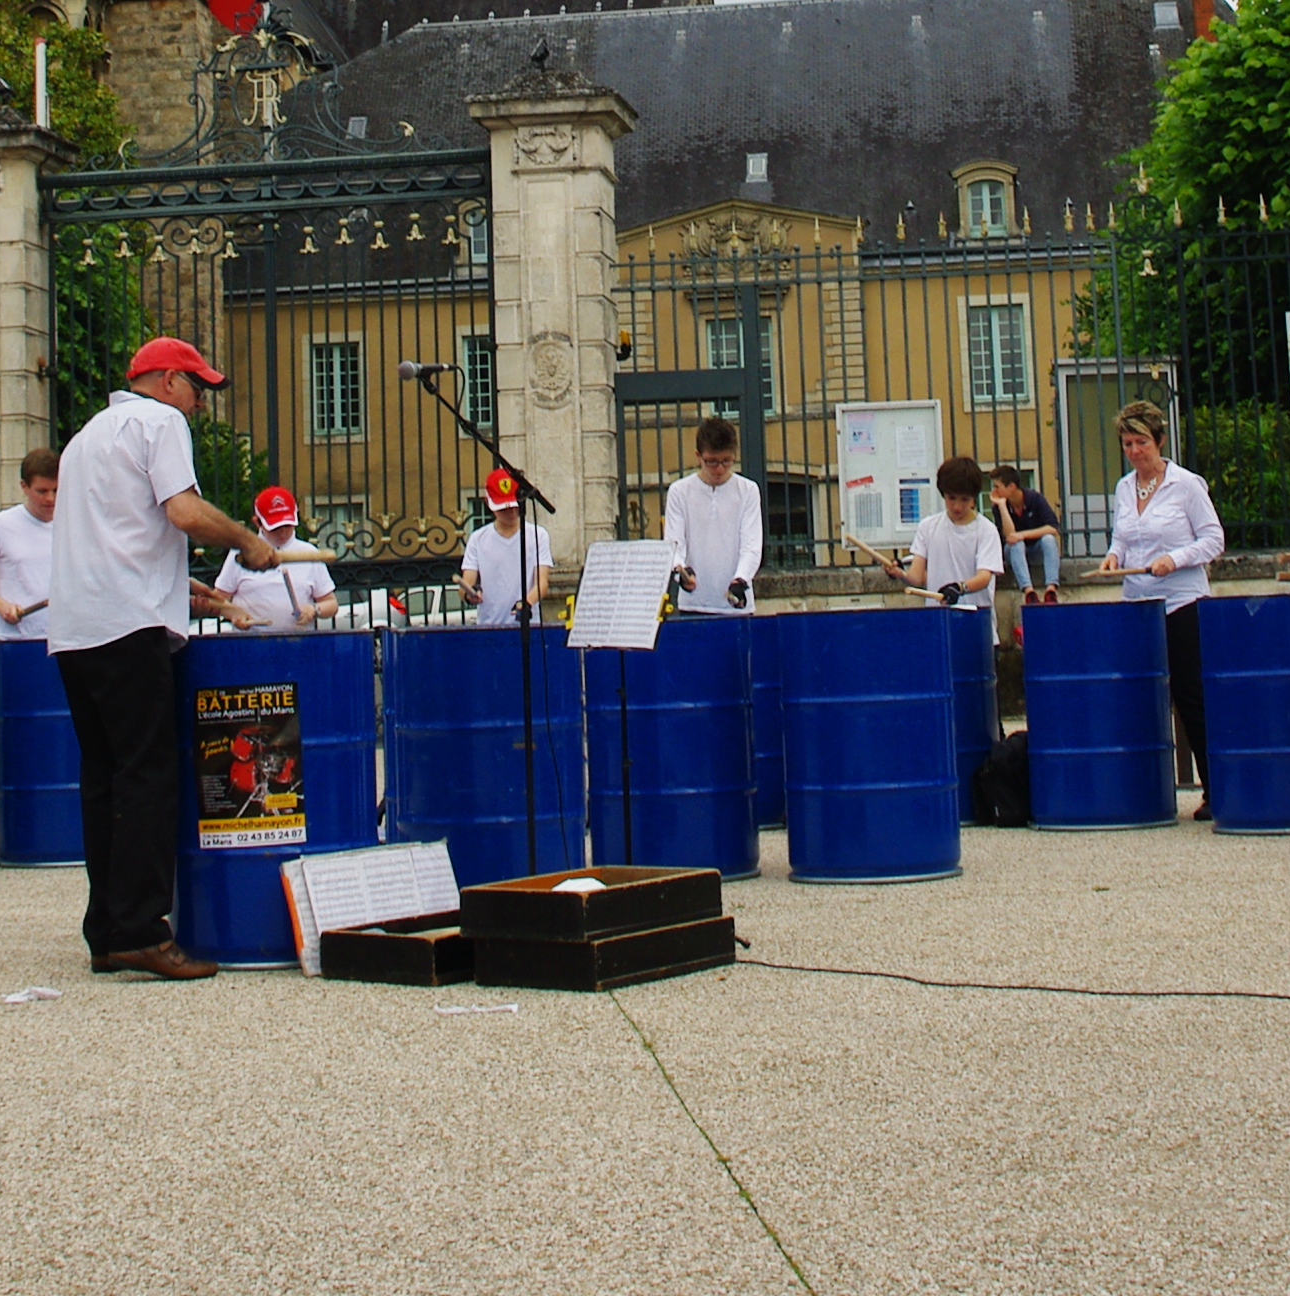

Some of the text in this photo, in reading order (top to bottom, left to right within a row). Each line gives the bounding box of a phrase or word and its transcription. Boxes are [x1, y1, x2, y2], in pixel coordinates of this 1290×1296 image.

[255, 684, 293, 693] HAMAYON
[197, 692, 294, 711] BATTERIE
[223, 709, 255, 719] Agostini
[260, 707, 271, 716] du
[272, 706, 295, 715] Mans
[202, 817, 302, 830] www.michelhamayon.fr
[202, 837, 232, 847] Le Mans
[237, 834, 248, 842] 02
[250, 832, 262, 841] 43
[264, 831, 276, 840] 85
[278, 830, 289, 839] 24
[291, 829, 303, 838] 87
